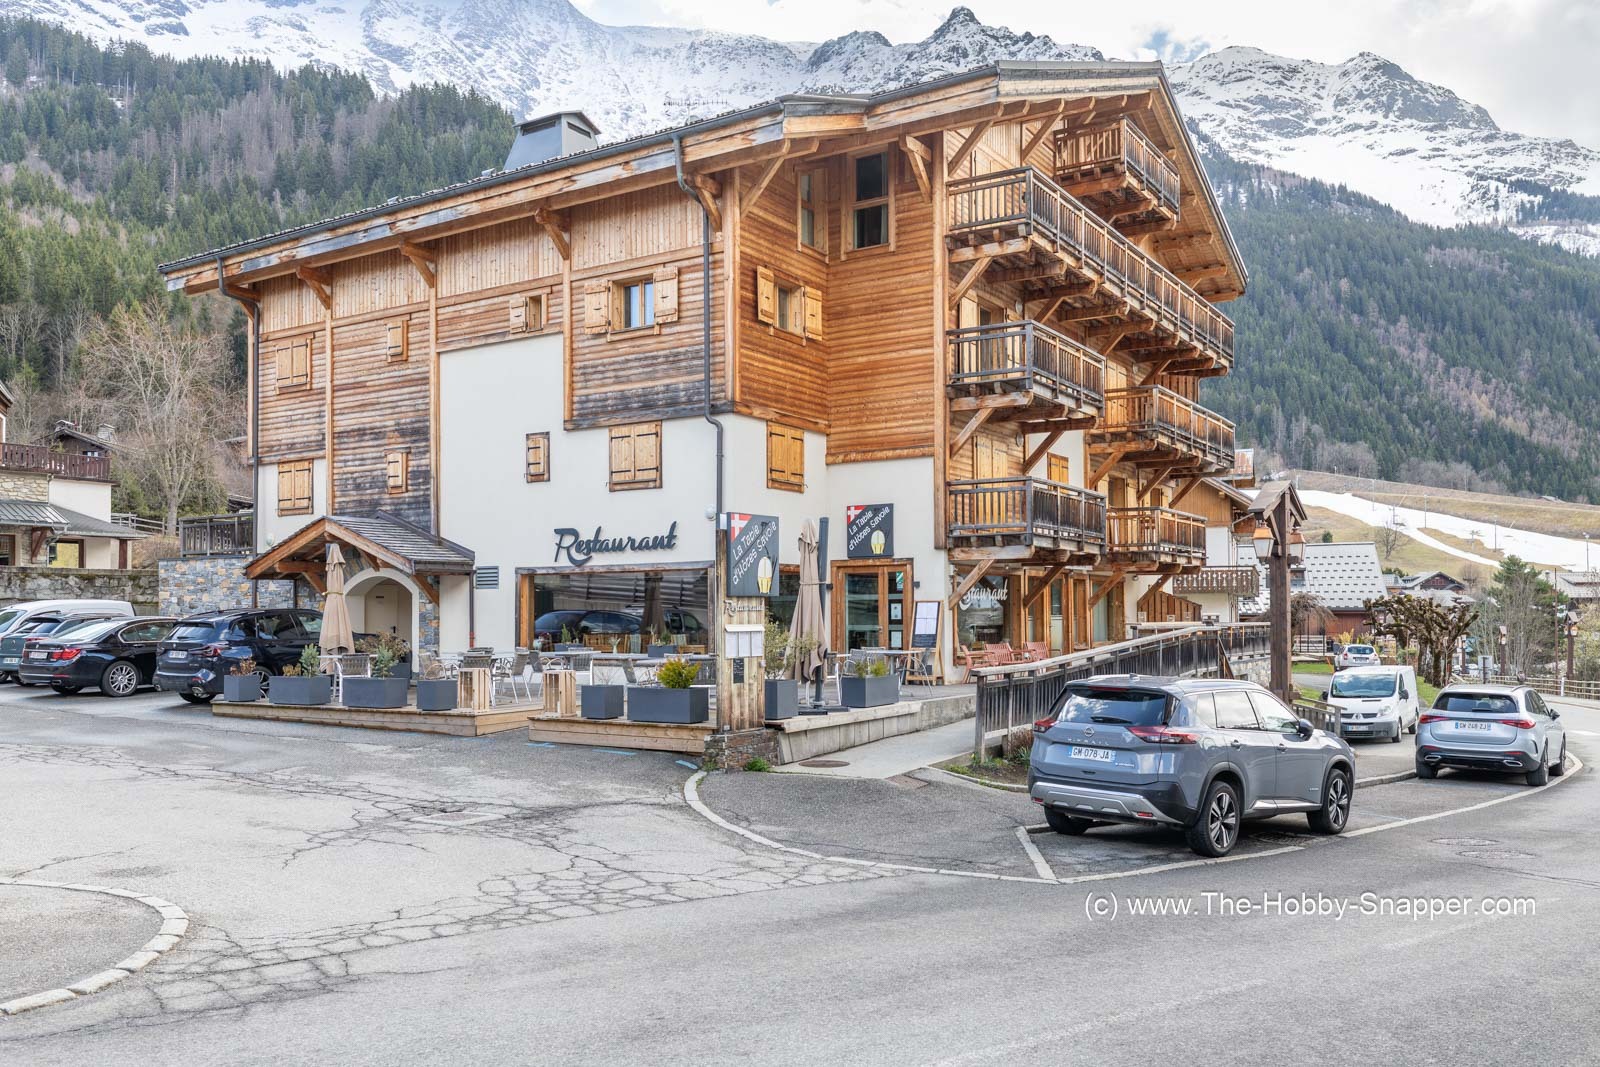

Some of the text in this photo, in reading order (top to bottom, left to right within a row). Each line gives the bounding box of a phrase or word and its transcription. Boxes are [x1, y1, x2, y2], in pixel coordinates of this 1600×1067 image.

[732, 524, 760, 560] La Table
[849, 510, 873, 535] La Table
[849, 506, 890, 550] d'Hôtes Savoie
[553, 520, 678, 567] Restaurant
[732, 521, 777, 585] d'Hôtes Savoie
[957, 578, 1009, 611] staurant
